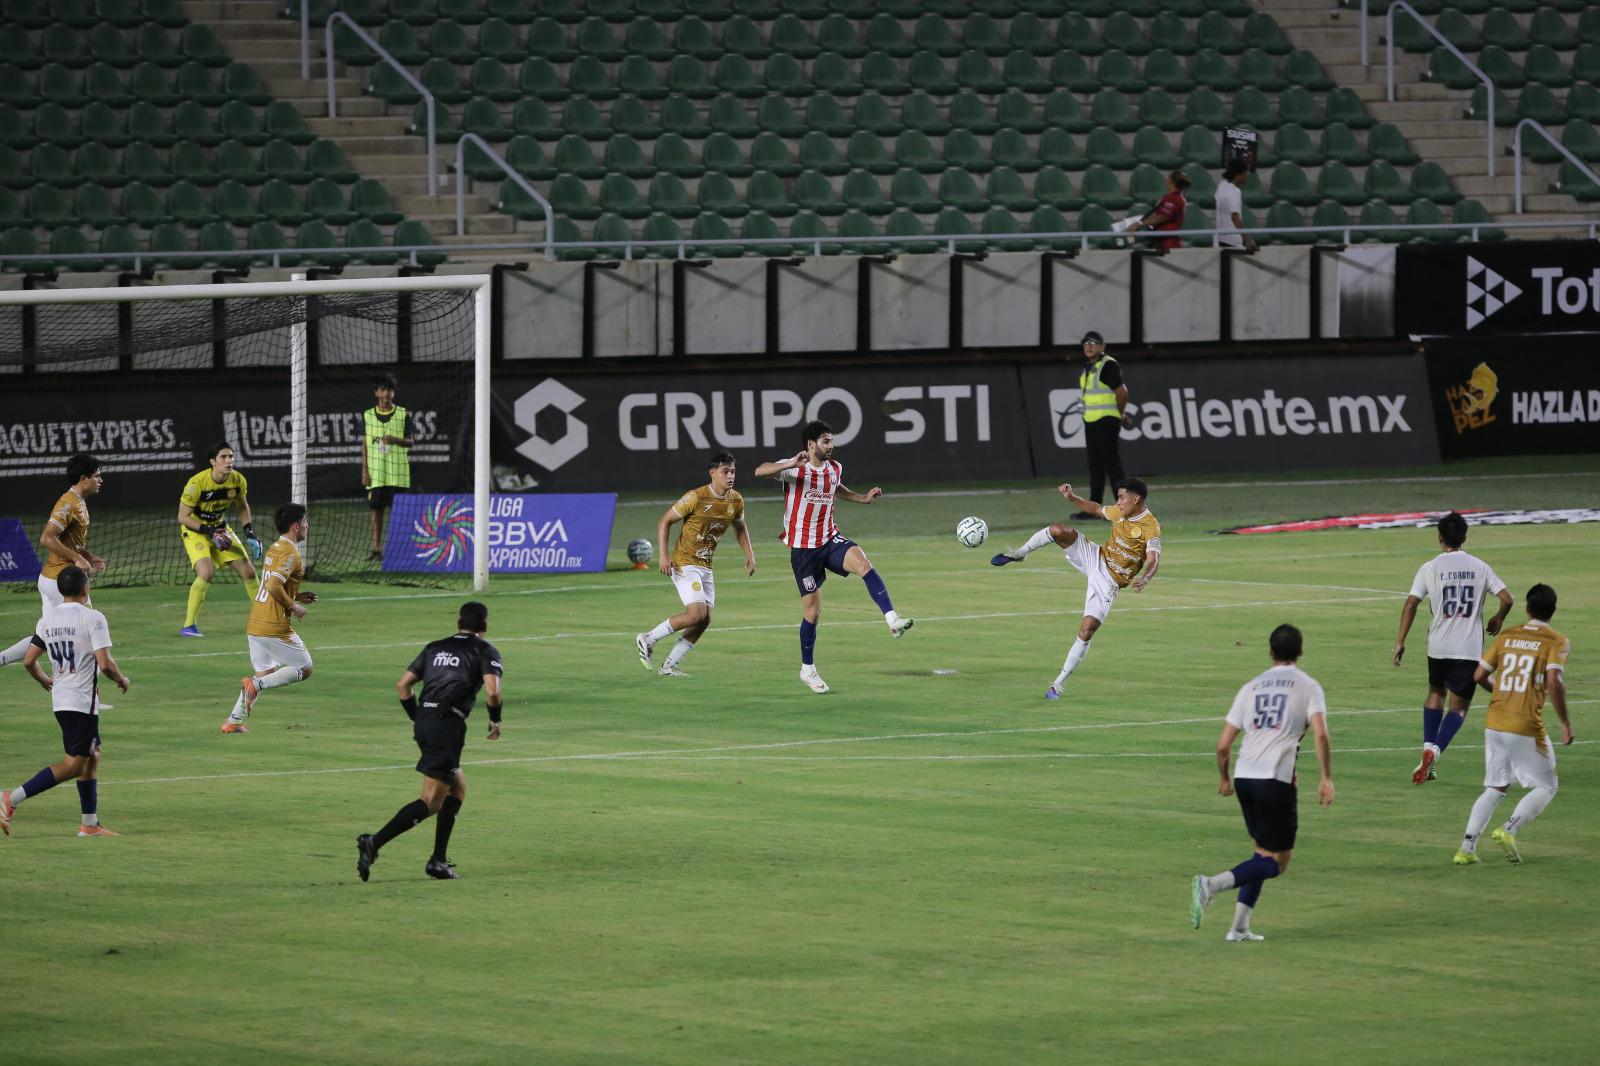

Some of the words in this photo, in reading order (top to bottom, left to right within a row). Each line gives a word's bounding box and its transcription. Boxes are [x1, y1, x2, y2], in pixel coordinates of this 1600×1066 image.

[1226, 129, 1257, 141] SUSHI
[618, 387, 863, 450] GRUPO
[884, 384, 991, 444] STI
[1117, 387, 1412, 441] caliente.mx
[1512, 390, 1586, 424] HAZLA
[488, 497, 524, 518] LIGA
[487, 518, 568, 546] BBVA
[488, 539, 567, 569] XPANSIÓN
[1442, 585, 1475, 619] 65
[48, 640, 76, 674] 44
[1499, 652, 1536, 693] 23
[1253, 693, 1289, 730] 59
